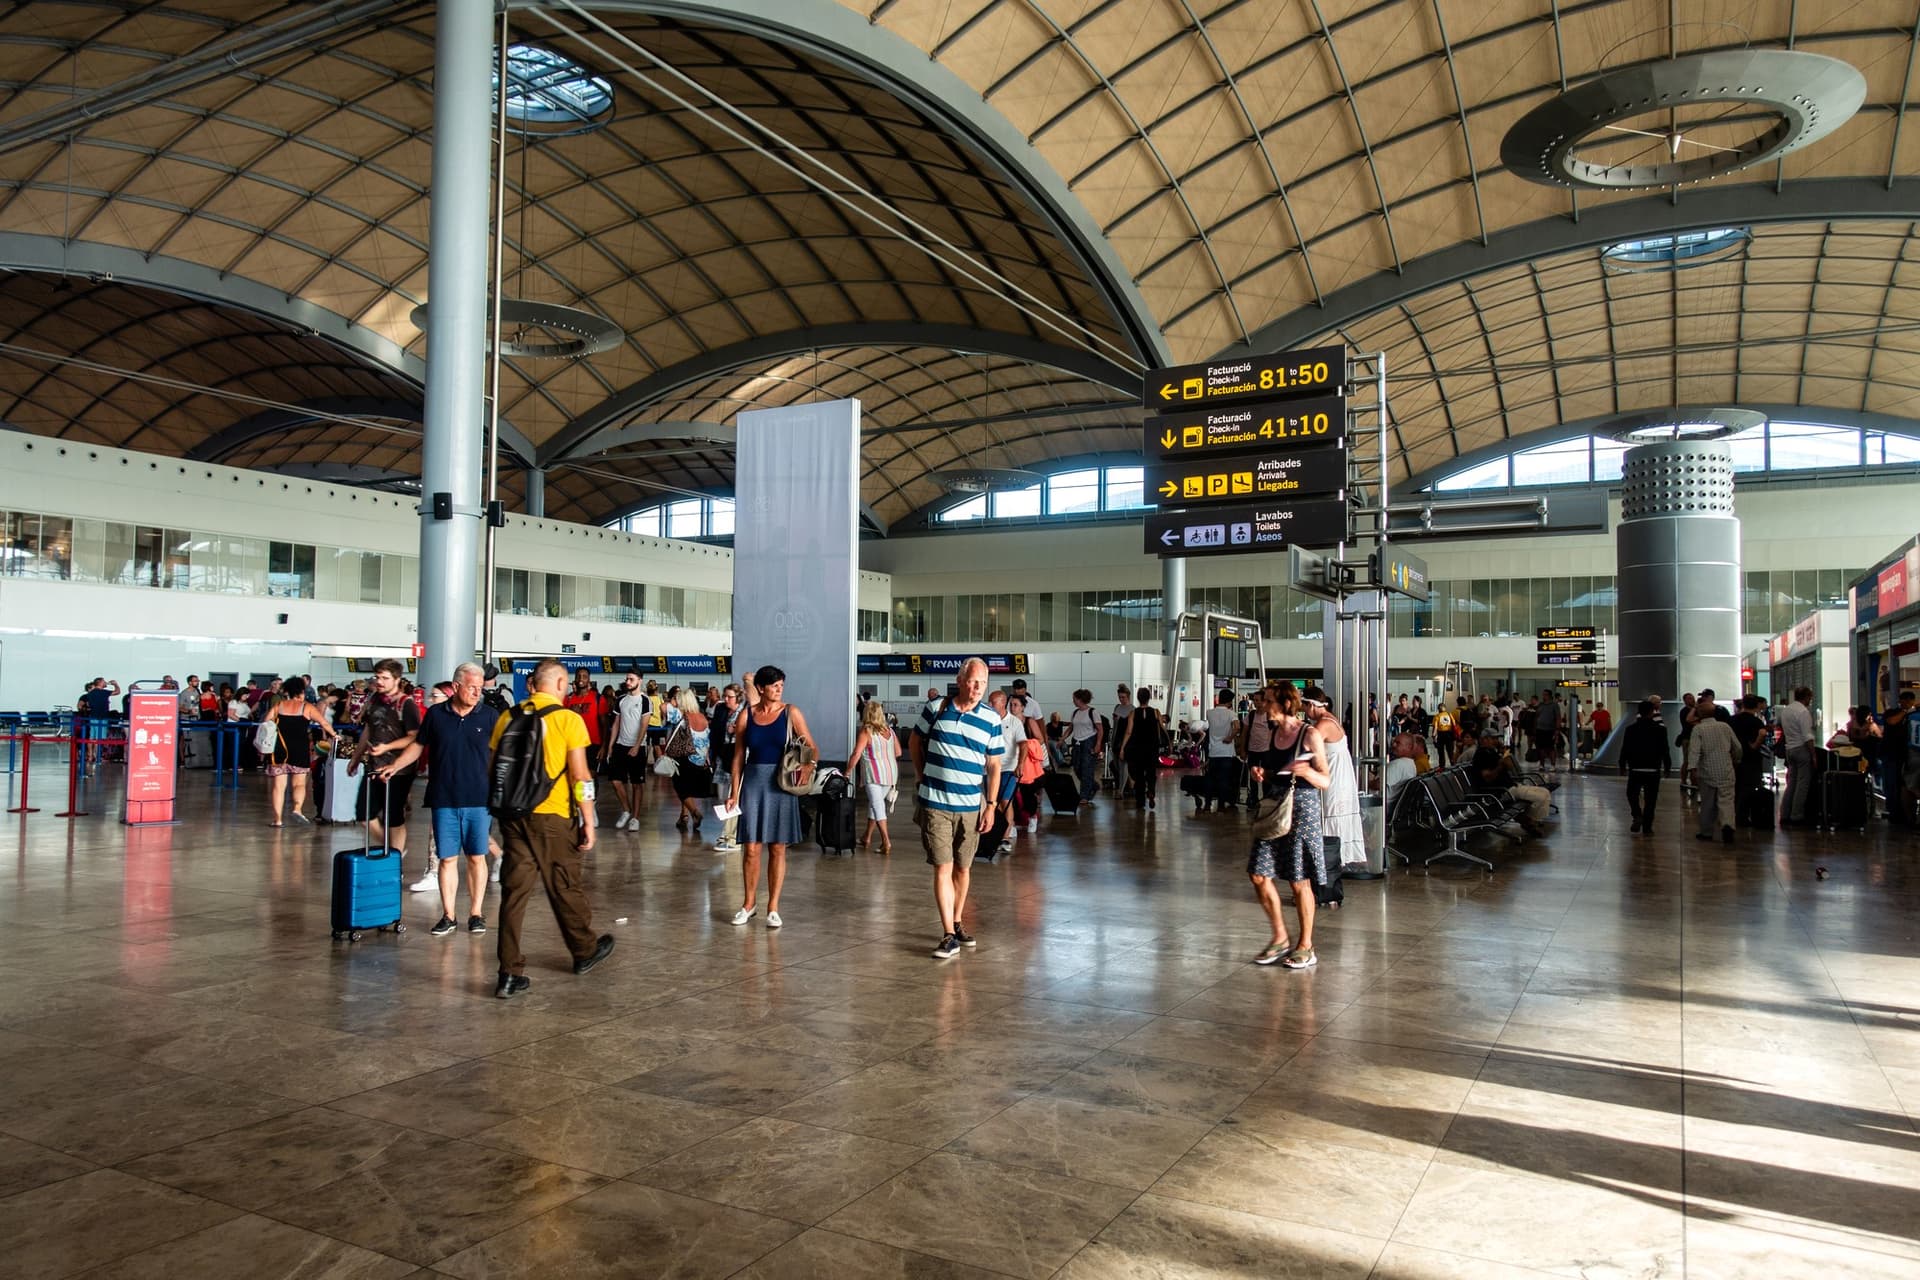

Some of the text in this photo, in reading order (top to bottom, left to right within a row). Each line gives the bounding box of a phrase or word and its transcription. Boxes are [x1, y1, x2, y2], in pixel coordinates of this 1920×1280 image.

[1208, 363, 1252, 376] Facturació
[1208, 374, 1240, 386] Check-in
[1259, 362, 1328, 389] 81 to 50
[1207, 382, 1257, 396] Facturación
[1208, 412, 1252, 425] Facturació
[1208, 424, 1240, 434] Check-in
[1259, 413, 1329, 439] 41 to 10
[1207, 431, 1257, 445] Facturación
[1257, 459, 1301, 470] Arribades
[1257, 471, 1287, 480] Arrivals
[1258, 479, 1299, 492] Llegadas
[1255, 510, 1293, 521] Lavabos
[1256, 522, 1281, 531] Toilets
[1255, 532, 1282, 542] Aseos
[677, 660, 712, 668] RYANAIR
[912, 665, 921, 673] 51
[933, 660, 962, 668] RYAN
[1015, 665, 1026, 673] 50
